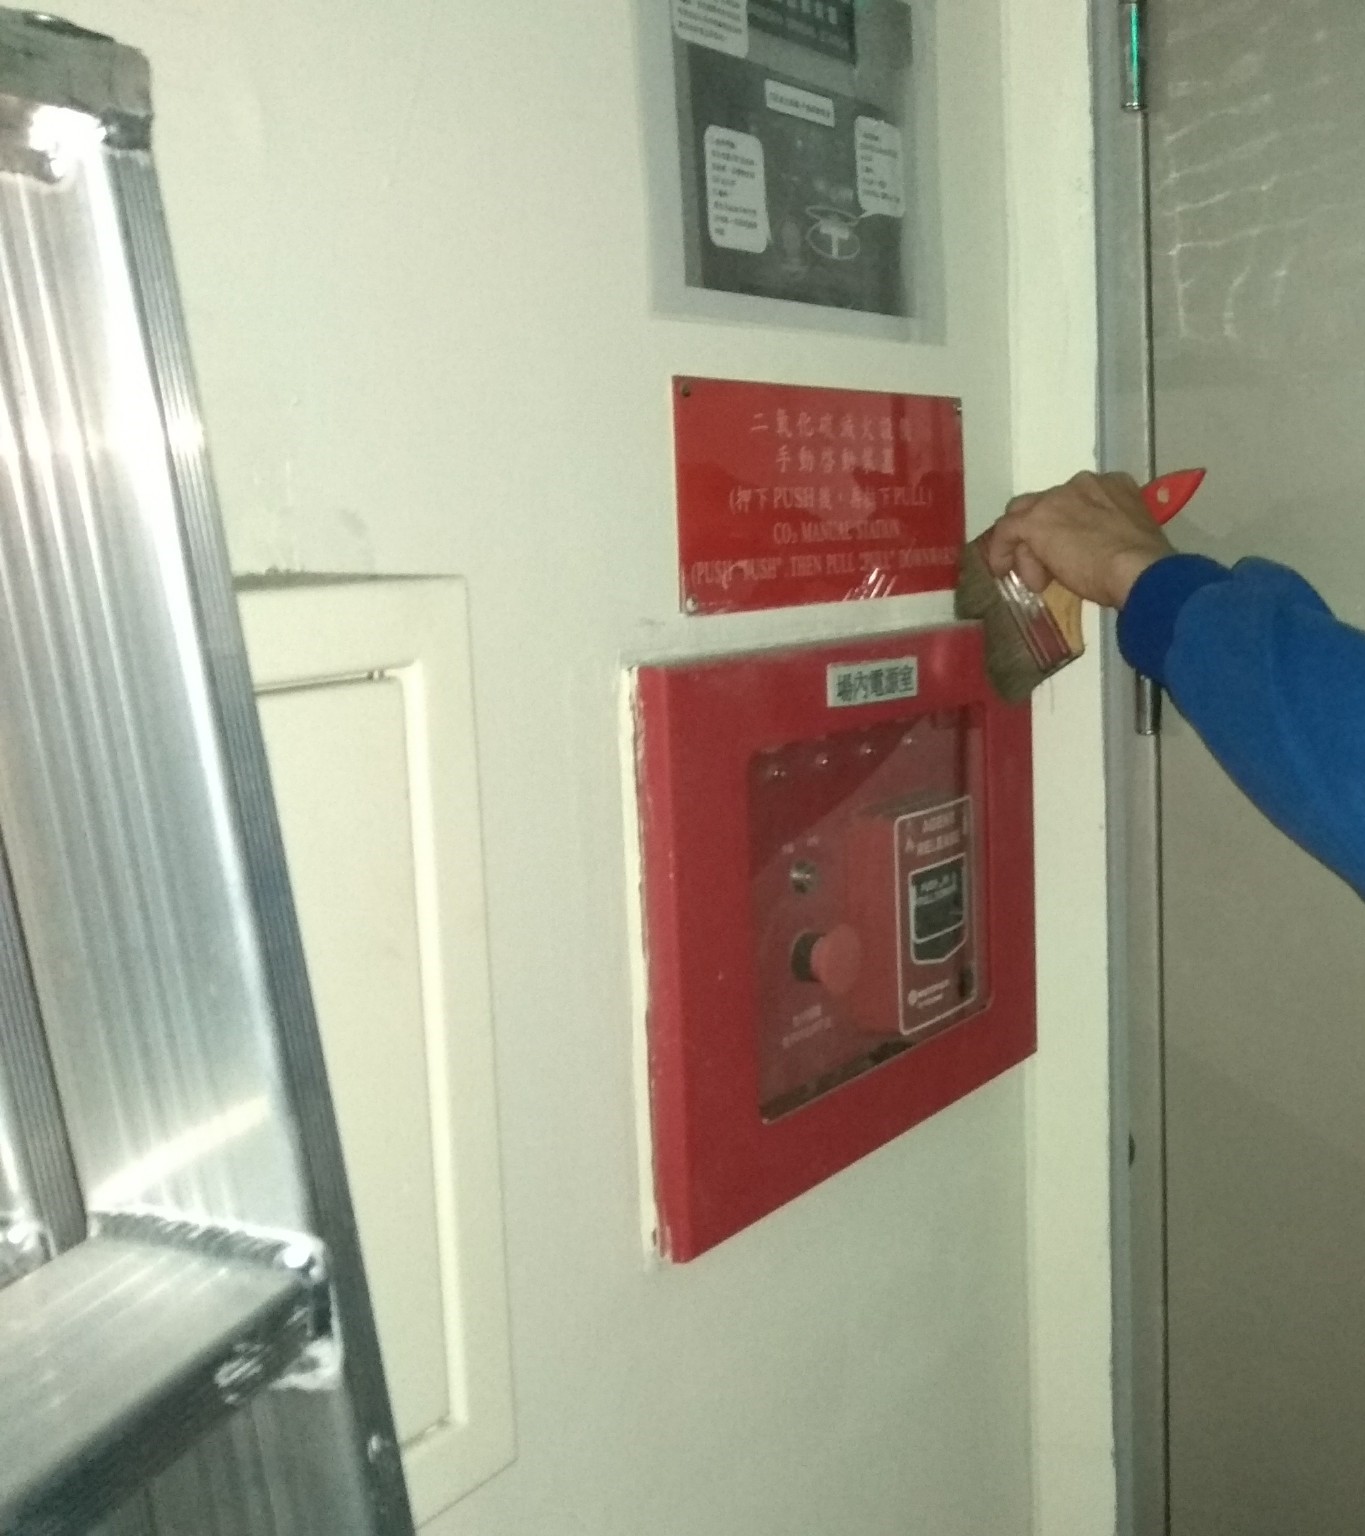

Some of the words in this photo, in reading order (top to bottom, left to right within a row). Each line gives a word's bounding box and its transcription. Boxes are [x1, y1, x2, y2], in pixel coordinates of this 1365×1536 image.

[790, 554, 822, 577] THEN
[826, 552, 855, 575] PULL
[836, 664, 914, 702] 場內電源室
